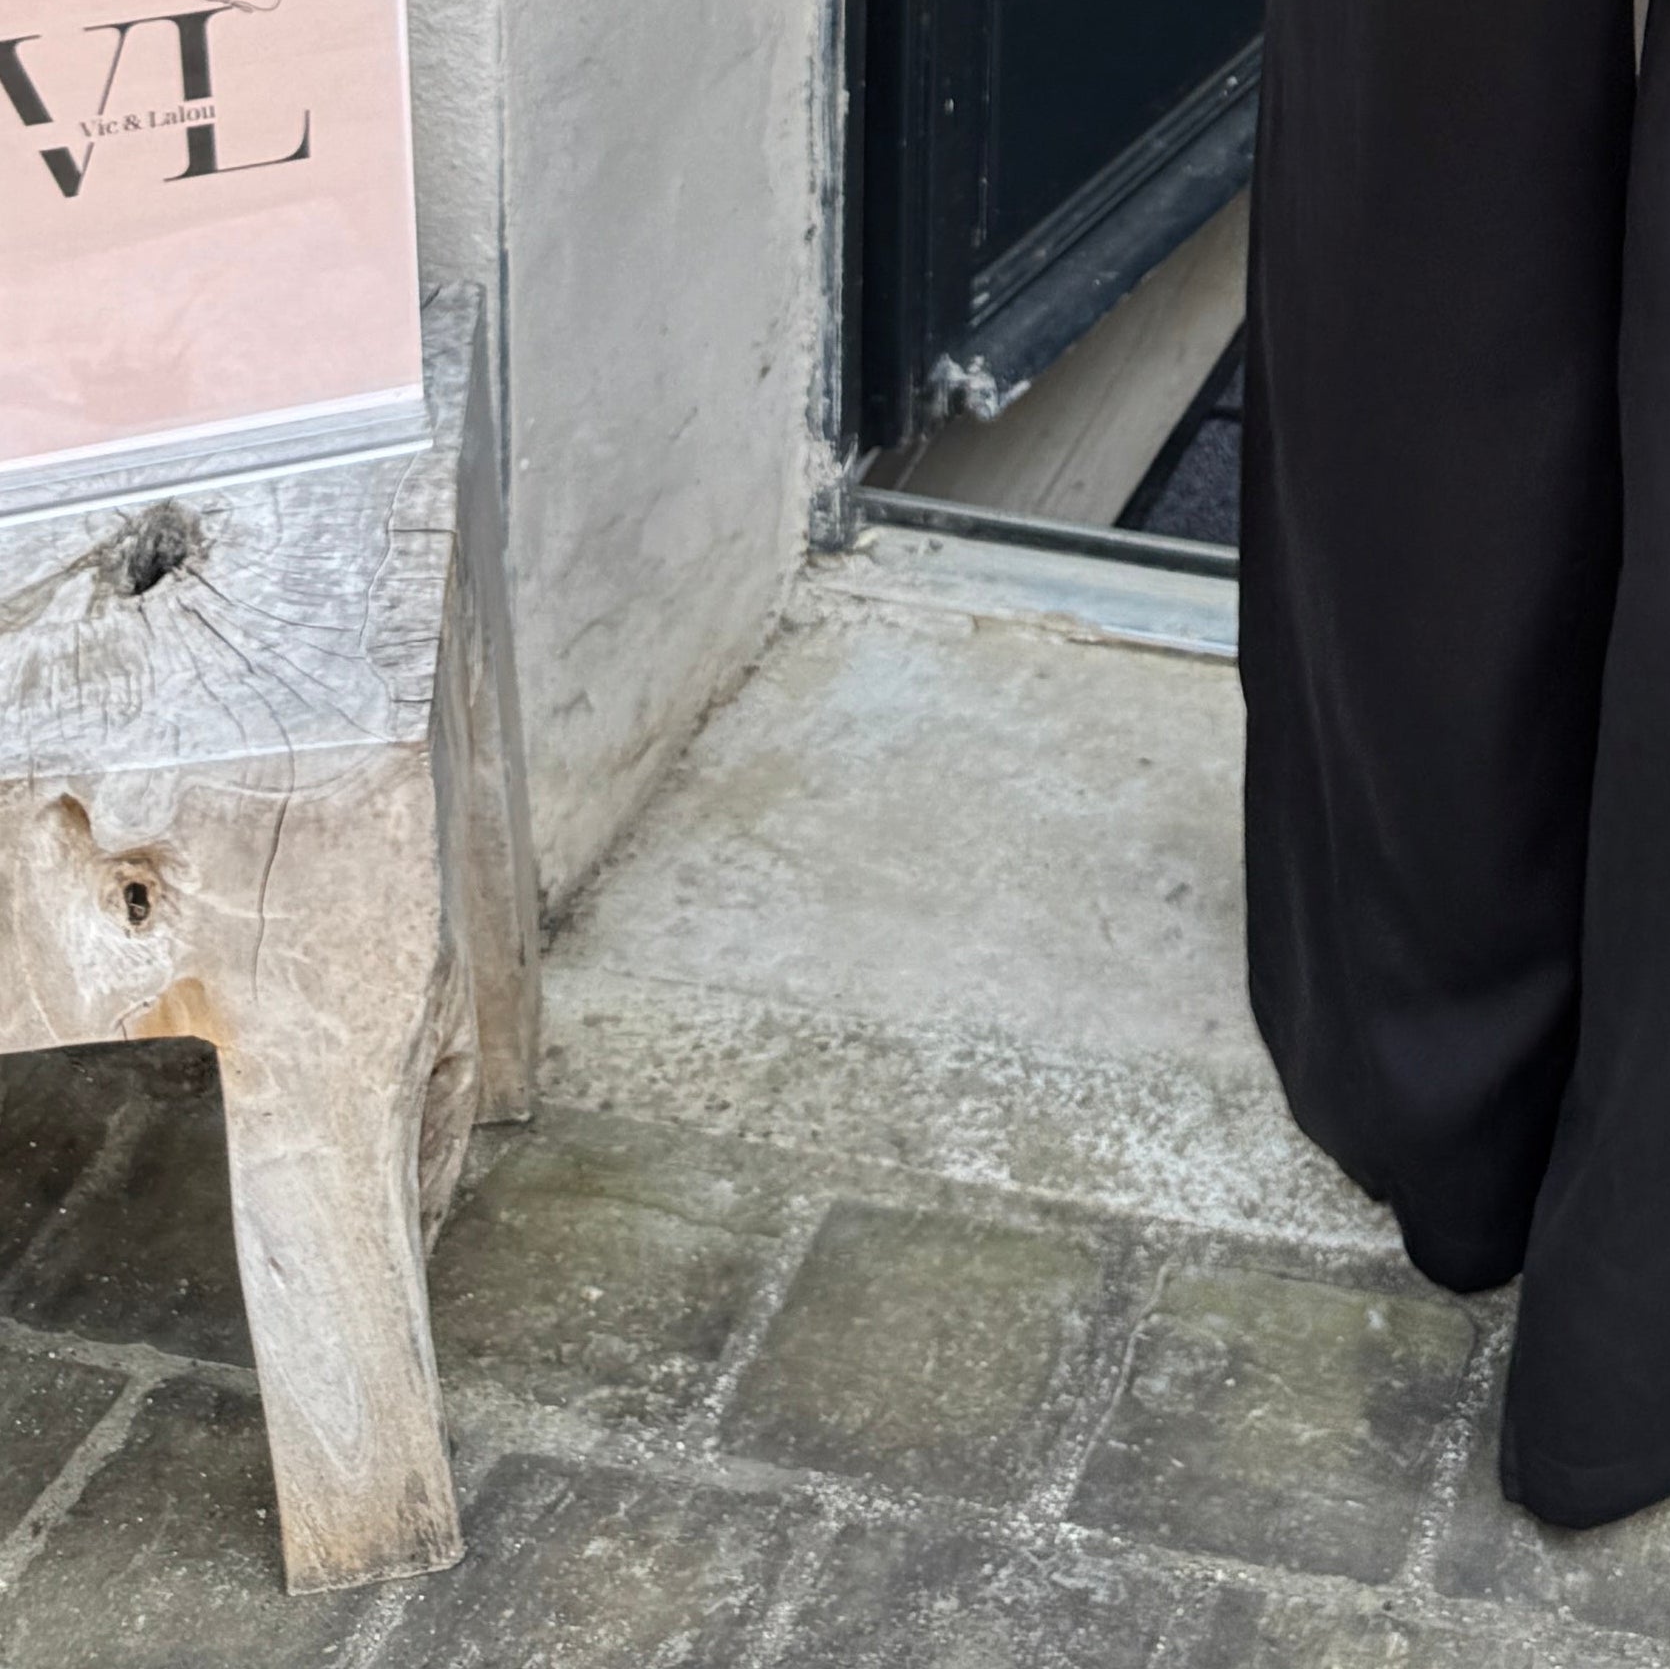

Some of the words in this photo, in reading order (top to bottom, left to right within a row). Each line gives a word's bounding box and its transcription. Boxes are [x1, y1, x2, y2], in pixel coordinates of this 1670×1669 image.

[79, 118, 119, 138] Vic
[122, 113, 142, 131] &
[149, 104, 216, 128] Lalou
